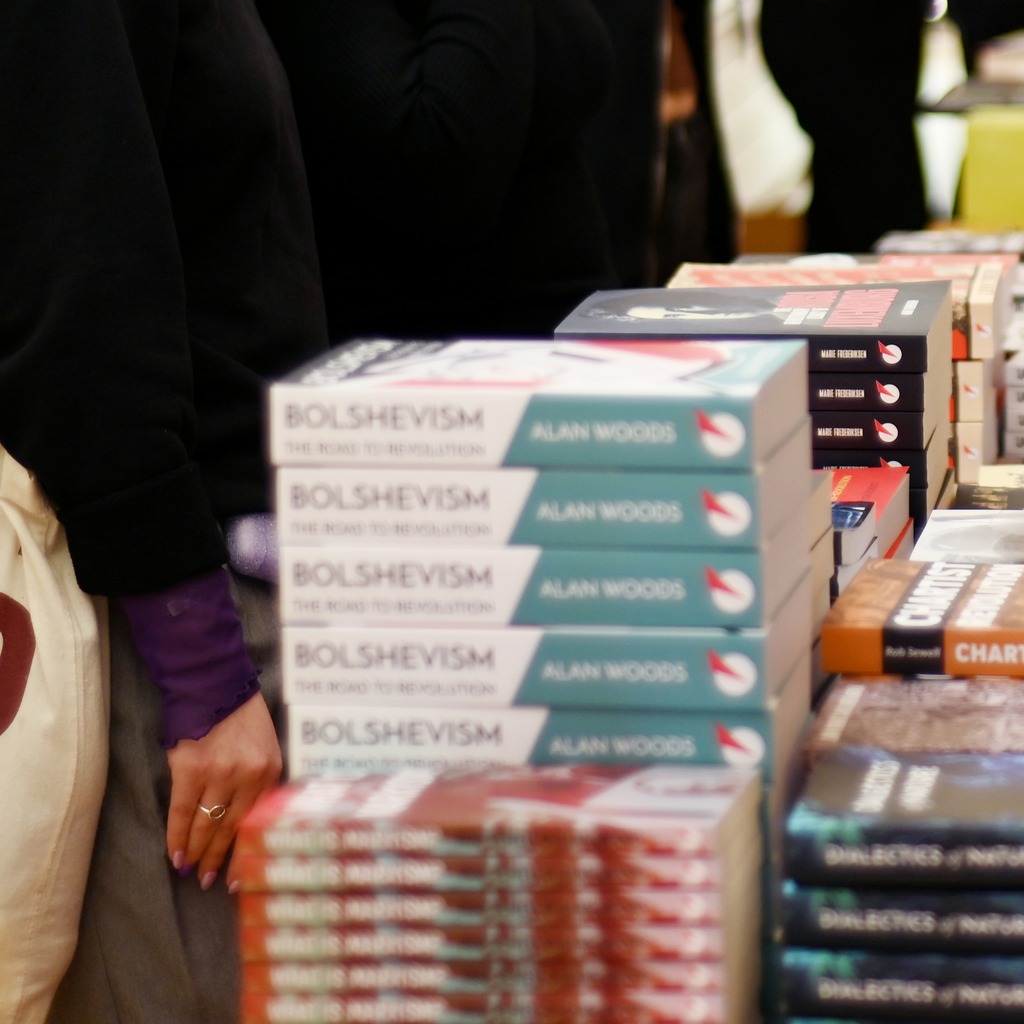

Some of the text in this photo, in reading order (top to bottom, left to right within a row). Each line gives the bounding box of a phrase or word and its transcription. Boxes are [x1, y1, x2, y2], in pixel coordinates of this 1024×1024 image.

[820, 350, 867, 358] MARIE FREDERIKSEN
[818, 389, 865, 398] MARIE FREDERIKSEN
[286, 403, 484, 430] BOLSHEVISM
[531, 421, 677, 444] ALAN WOODS
[818, 428, 864, 436] MARIE FREDERIKSEN
[290, 484, 490, 511] BOLSHEVISM
[537, 500, 683, 522] ALAN WOODS
[293, 561, 494, 588] BOLSHEVISM
[540, 578, 686, 600] ALAN WOODS
[894, 562, 976, 626] CHARTIST
[294, 644, 496, 670] BOLSHEVISM
[542, 661, 689, 683] ALAN WOODS
[302, 720, 502, 746] BOLSHEVISM
[550, 736, 697, 757] ALAN WOODS
[824, 844, 944, 866] DIALECTICS
[818, 908, 937, 932] DIALECTICS
[818, 978, 937, 1004] DIALECTICS
